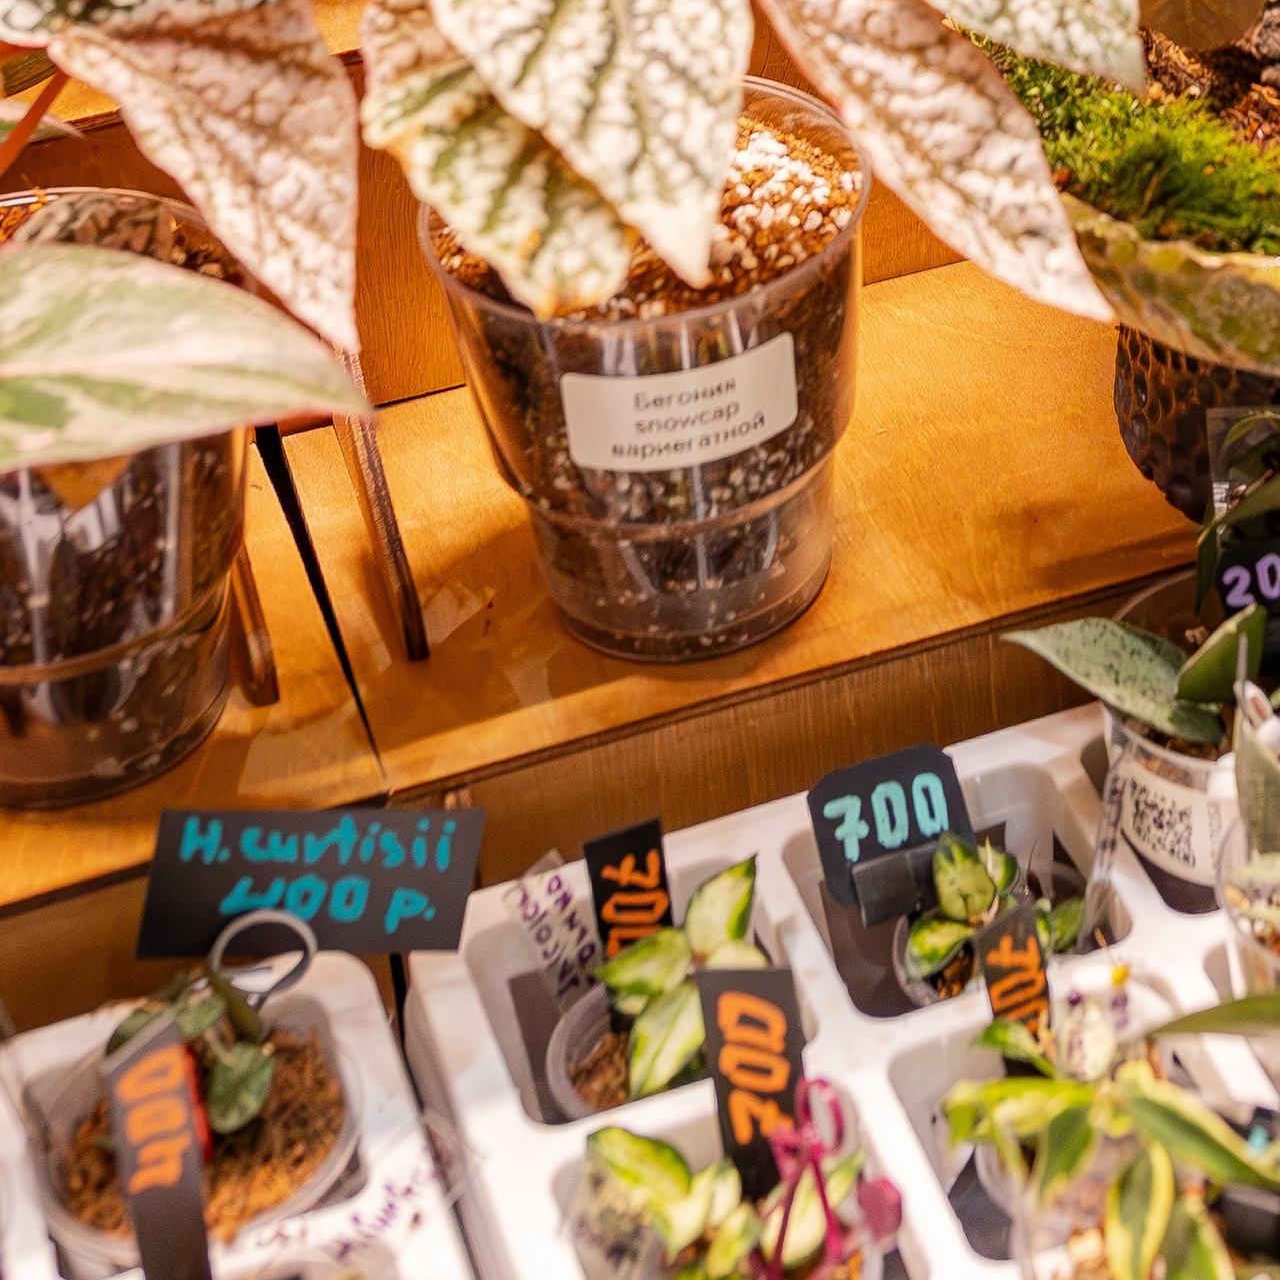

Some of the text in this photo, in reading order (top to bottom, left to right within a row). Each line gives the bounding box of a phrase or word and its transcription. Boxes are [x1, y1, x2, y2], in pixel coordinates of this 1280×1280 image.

[633, 377, 737, 412] Бегония
[823, 772, 950, 864] 700
[716, 991, 796, 1147] 700
